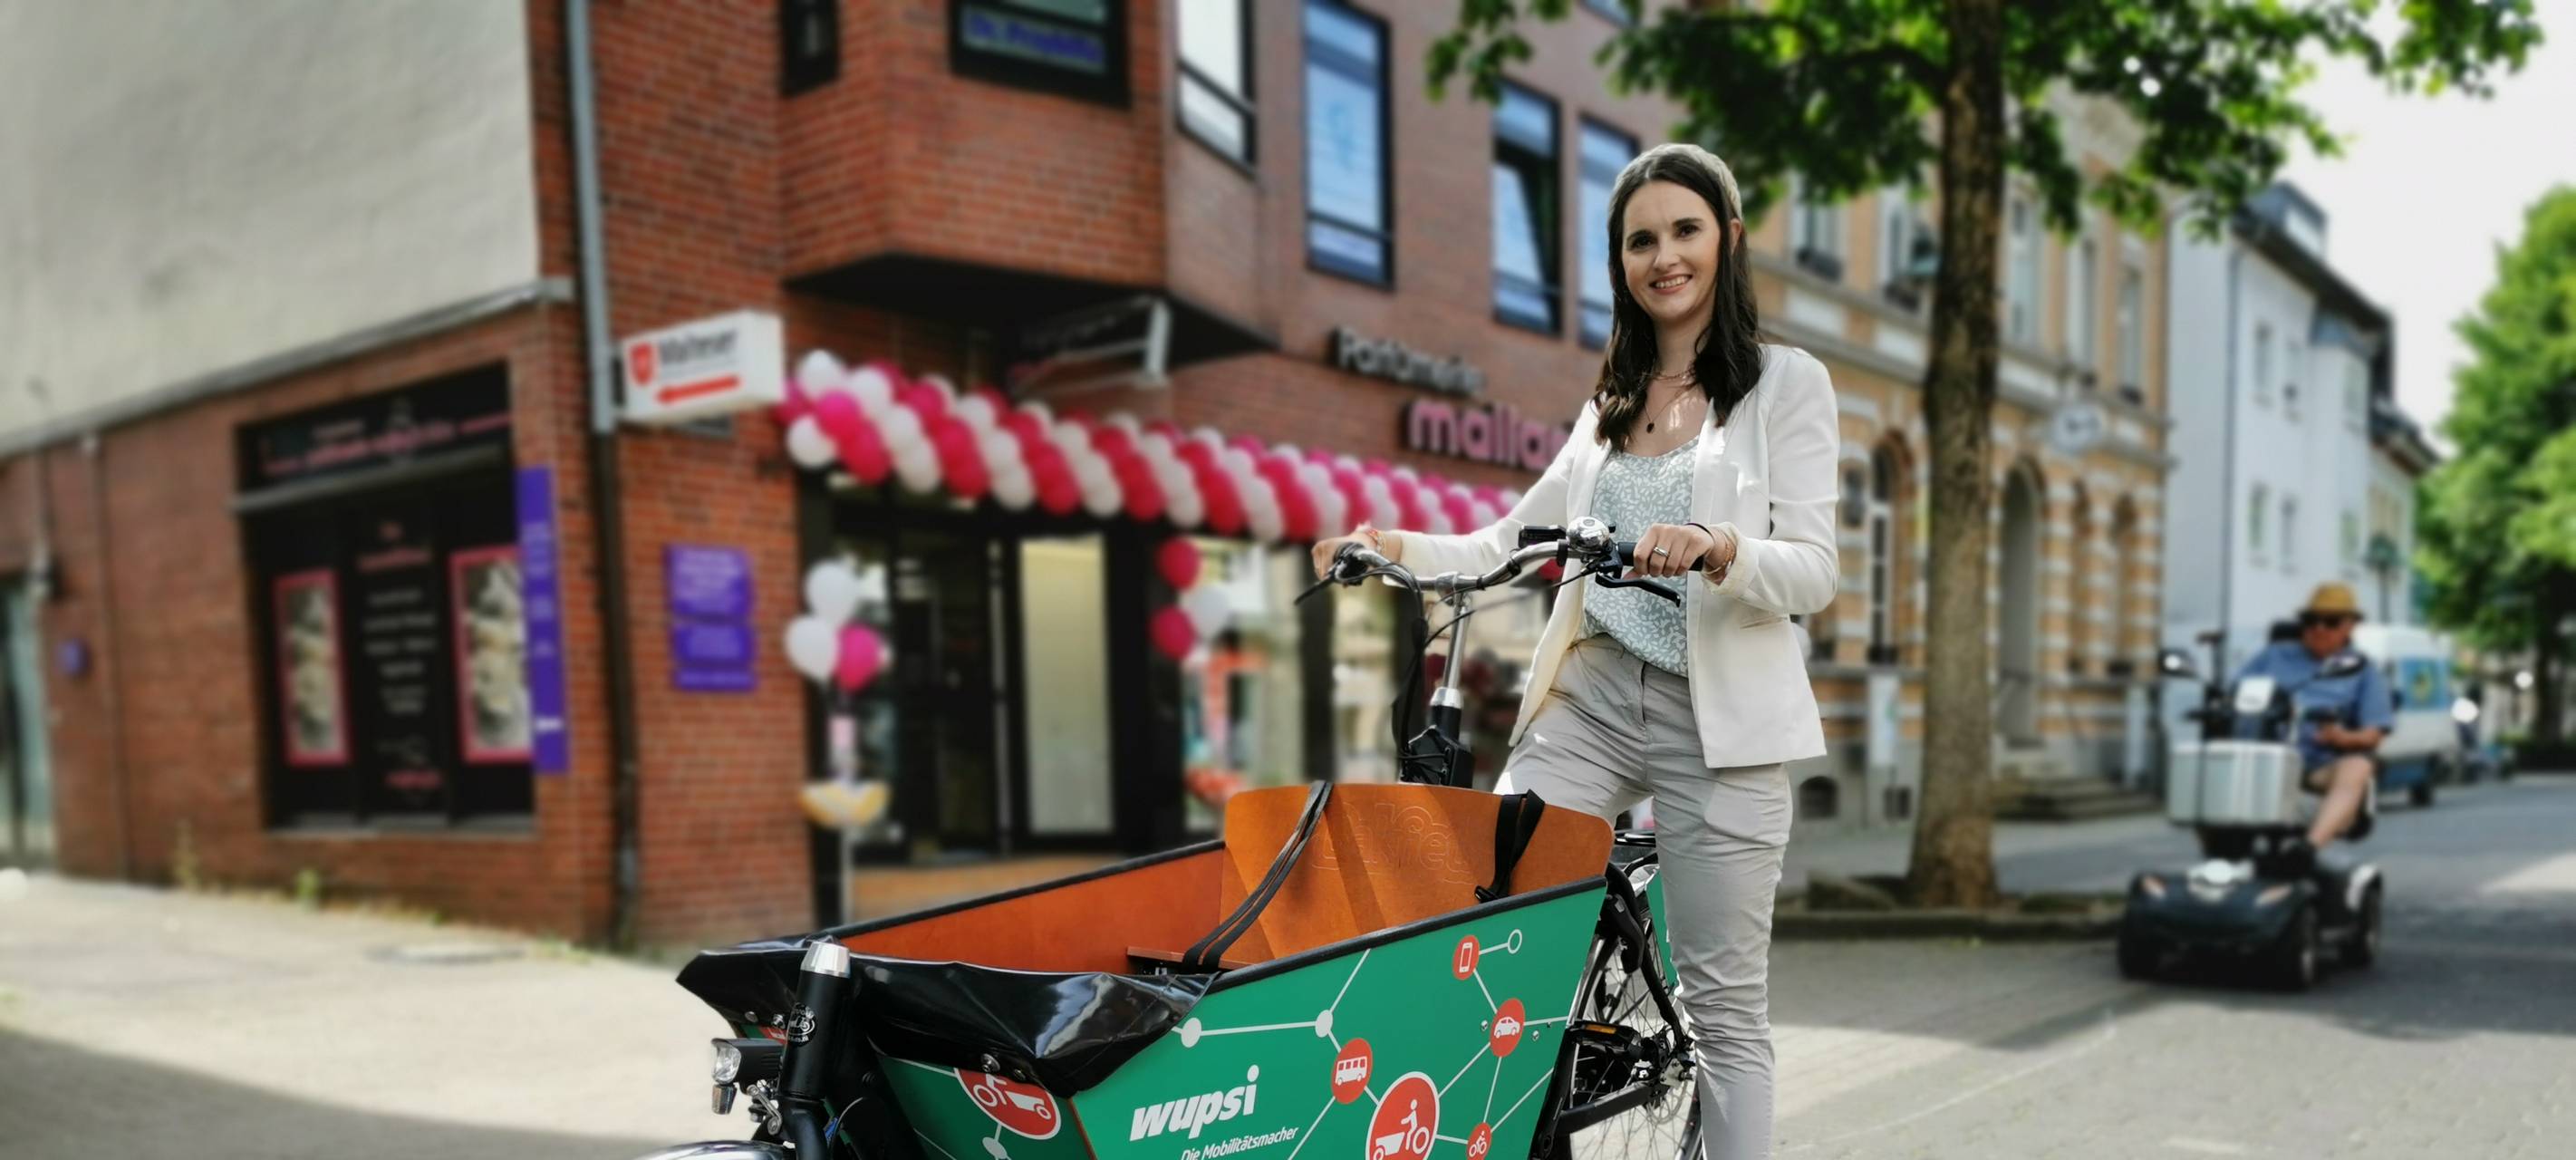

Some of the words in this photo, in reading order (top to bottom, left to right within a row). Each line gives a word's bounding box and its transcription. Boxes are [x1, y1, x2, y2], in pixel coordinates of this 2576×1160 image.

[1129, 1064, 1259, 1142] wupsi
[1181, 1148, 1201, 1160] Die
[1201, 1126, 1299, 1160] Mobilitätsmacher
